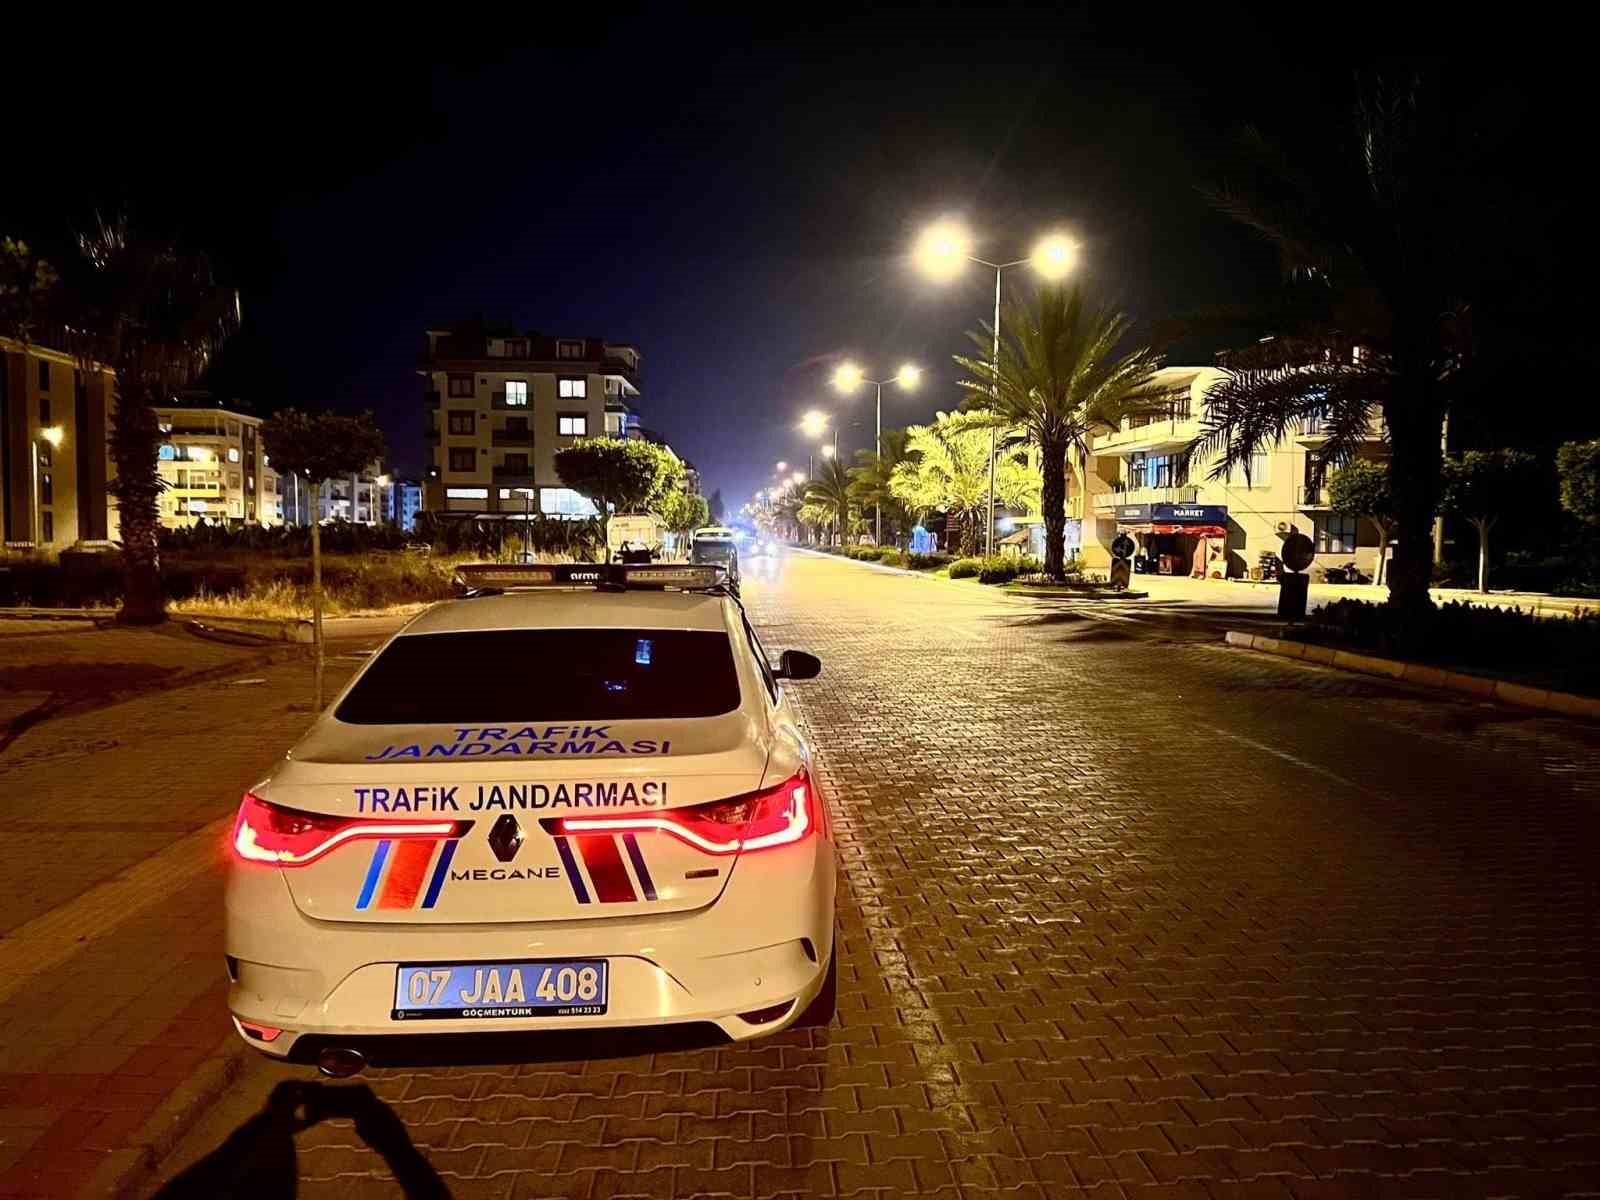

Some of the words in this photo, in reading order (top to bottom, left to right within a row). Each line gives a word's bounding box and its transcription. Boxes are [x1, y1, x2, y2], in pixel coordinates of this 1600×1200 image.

[1174, 509, 1204, 517] MARKET
[365, 740, 671, 760] JANDARMASI
[469, 781, 667, 811] JANDARMASI
[451, 867, 561, 881] MEGANE
[408, 970, 451, 1005] 07
[459, 968, 526, 1004] JAA
[535, 966, 599, 1002] 408
